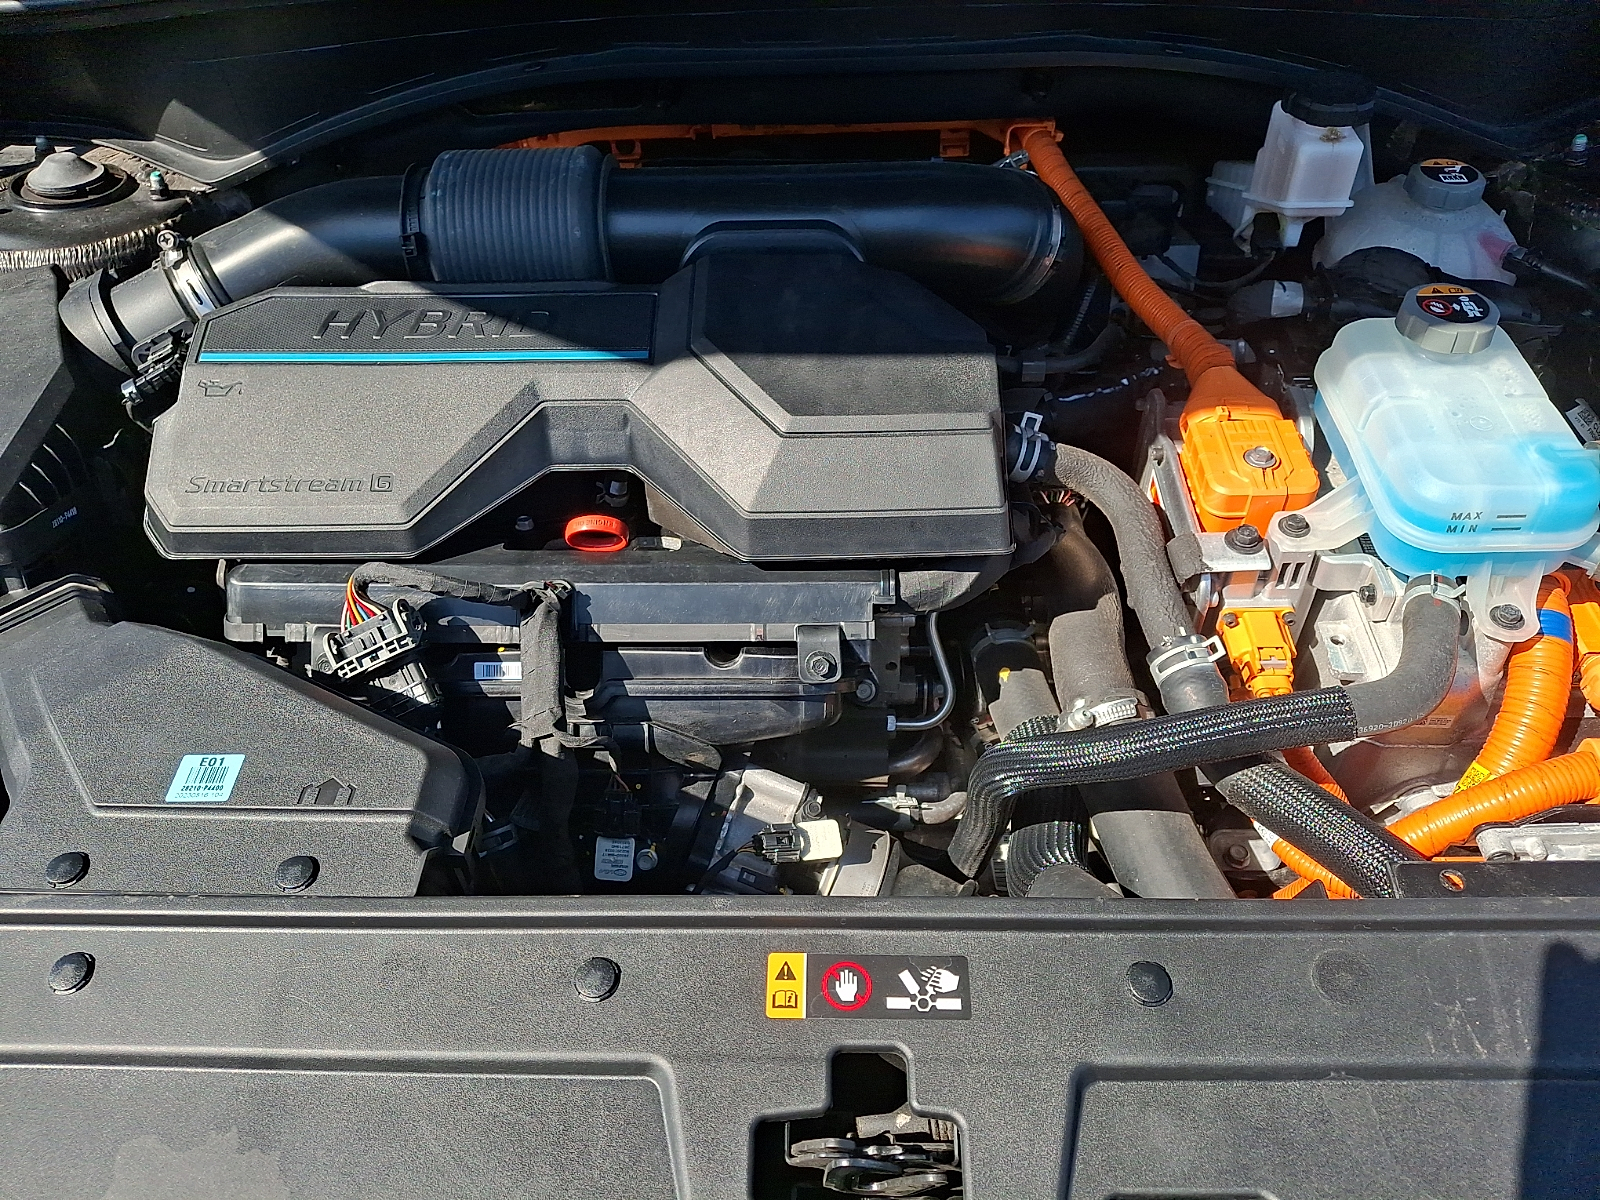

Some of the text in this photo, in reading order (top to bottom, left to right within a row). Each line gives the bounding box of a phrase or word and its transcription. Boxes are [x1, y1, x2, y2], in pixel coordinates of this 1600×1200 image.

[313, 309, 549, 339] HYBRID
[185, 474, 394, 493] Smartstream G
[1450, 511, 1483, 521] MAX
[1446, 524, 1478, 533] MIN
[200, 757, 225, 766] E01
